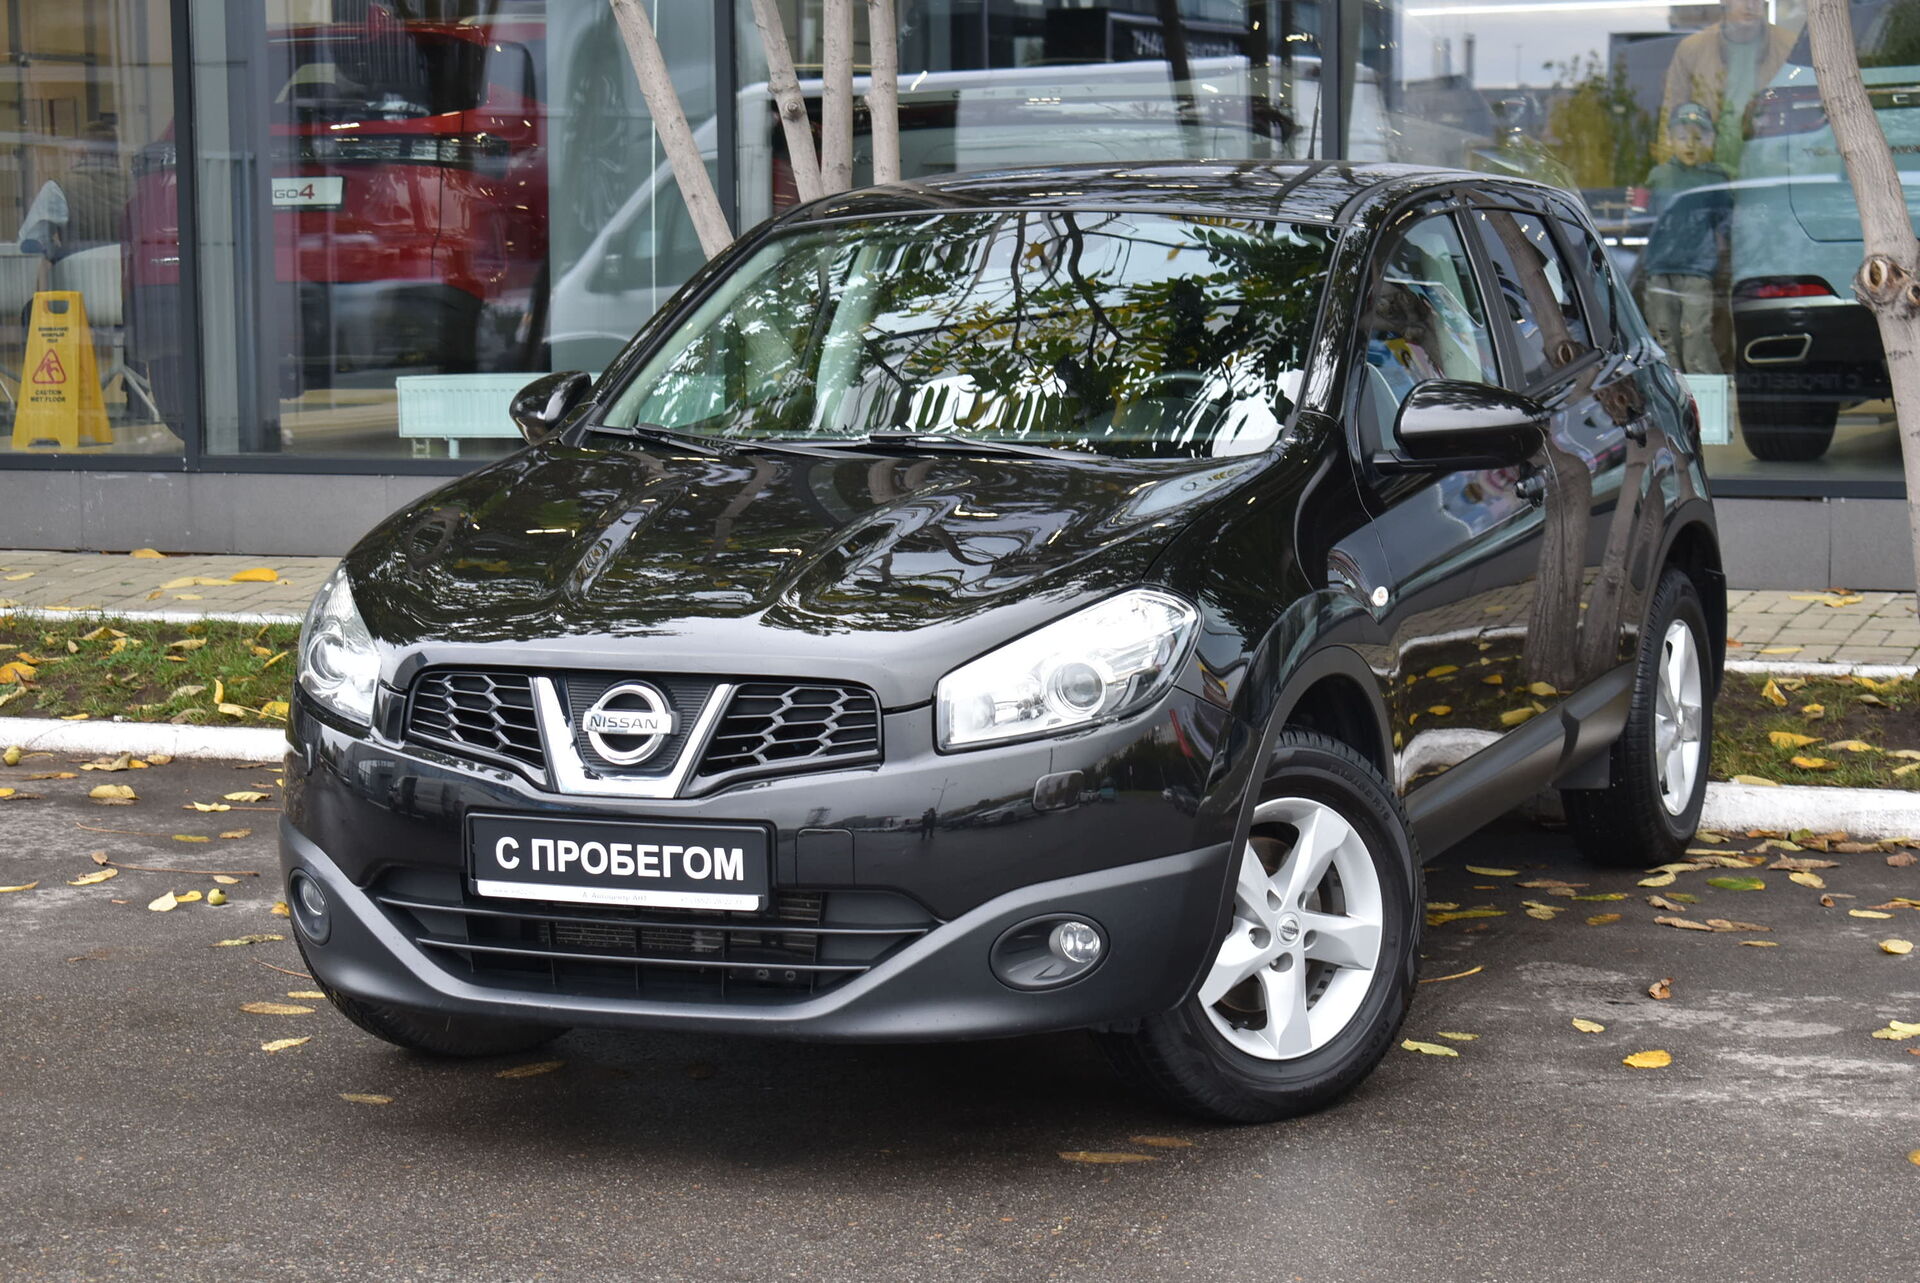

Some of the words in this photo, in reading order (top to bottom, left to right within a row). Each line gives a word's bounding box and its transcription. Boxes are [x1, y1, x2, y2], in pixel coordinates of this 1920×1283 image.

[589, 714, 659, 730] NISSAN
[495, 836, 521, 870] С
[531, 838, 745, 881] ПРОБЕГОМ
